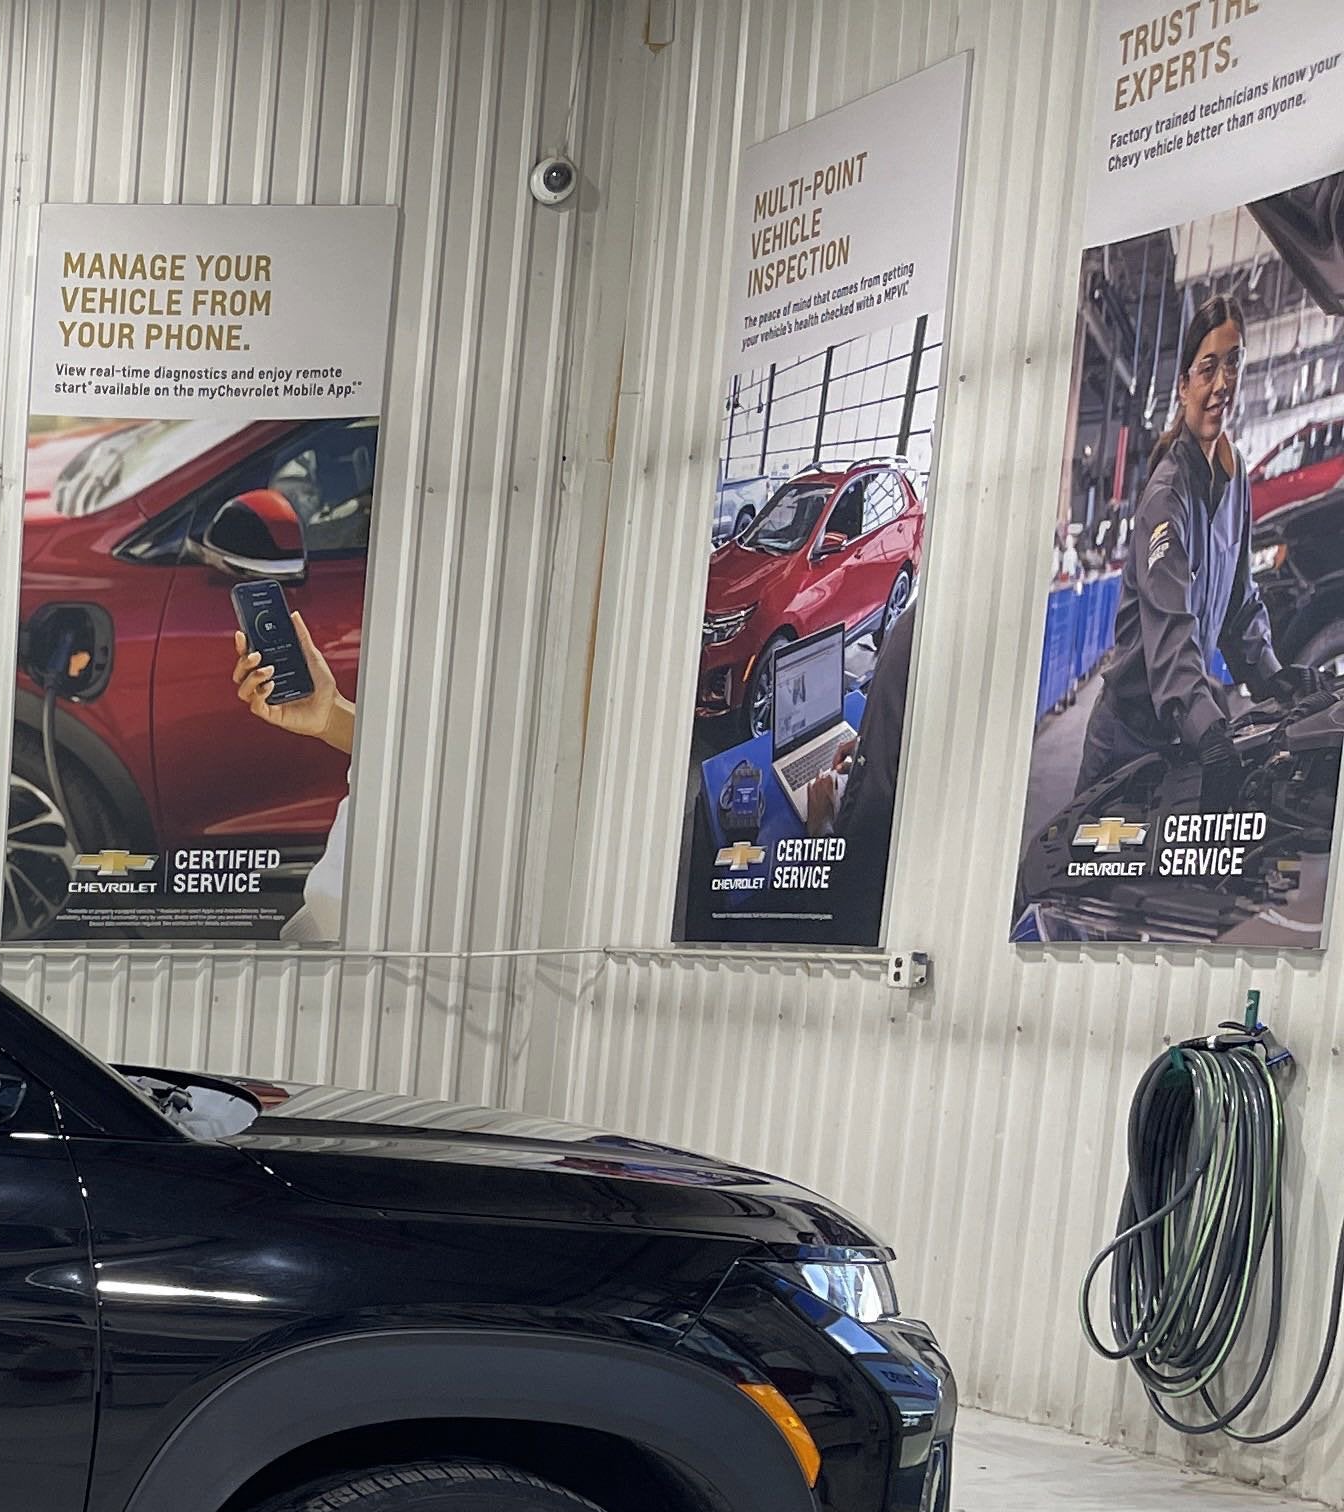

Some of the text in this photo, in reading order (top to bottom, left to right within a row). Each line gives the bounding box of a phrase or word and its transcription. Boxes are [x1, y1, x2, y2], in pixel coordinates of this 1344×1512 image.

[1119, 1, 1201, 65] TRUST
[1114, 35, 1238, 112] EXPERTS.
[1110, 53, 1341, 150] Factory trained technicians know your
[1108, 92, 1307, 173] Chevy vehicle better than anyone.
[753, 151, 868, 223] MULTI-POINT
[751, 207, 823, 260] VEHICLE
[63, 252, 272, 282] MANAGE YOUR
[747, 234, 851, 298] INSPECTION
[61, 286, 271, 316] VEHICLE FROM
[744, 262, 915, 329] The peace of mind that comes from getting
[58, 320, 250, 351] YOUR PHONE.
[741, 332, 759, 352] your
[760, 321, 793, 342] vehicle's
[794, 312, 819, 332] health
[821, 300, 854, 323] checked
[856, 294, 875, 311] with
[876, 295, 882, 305] a
[55, 363, 343, 382] View real-time diagnostics and enjoy remote
[94, 382, 150, 396] available
[154, 386, 169, 396] on
[174, 384, 194, 397] the
[198, 384, 279, 400] myChevrolet
[282, 383, 323, 397] Mobile
[1163, 812, 1267, 843] CERTIFIED
[174, 849, 281, 870] CERTIFIED
[776, 838, 846, 862] CERTIFIED
[1159, 847, 1245, 876] SERVICE
[172, 872, 261, 893] SERVICE
[711, 877, 765, 890] CHEVROLET
[773, 866, 831, 889] SERVICE
[1067, 862, 1146, 877] CHEVROLET
[67, 882, 158, 894] CHEVROLET
